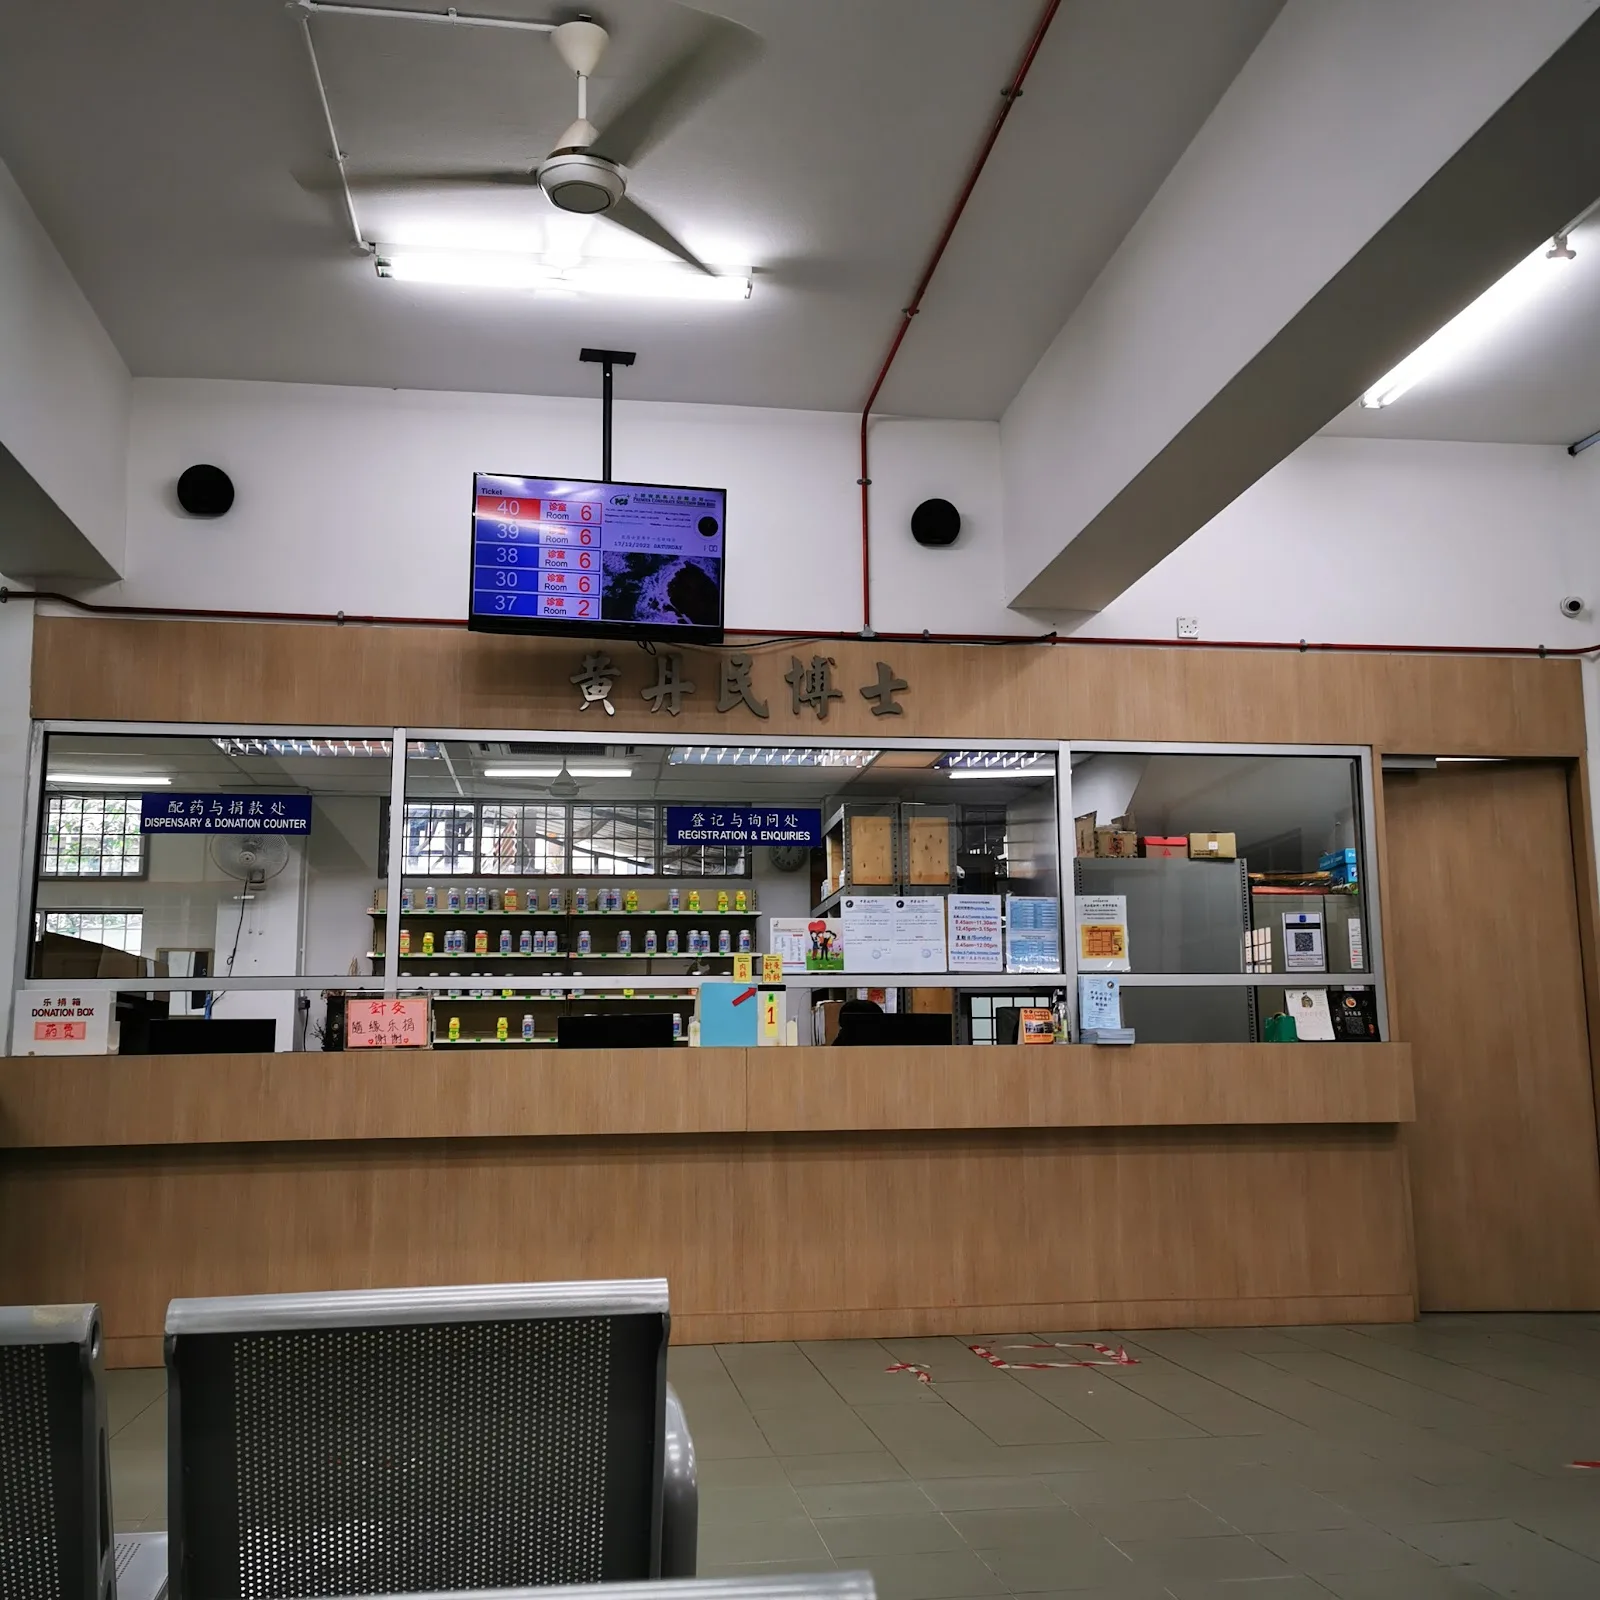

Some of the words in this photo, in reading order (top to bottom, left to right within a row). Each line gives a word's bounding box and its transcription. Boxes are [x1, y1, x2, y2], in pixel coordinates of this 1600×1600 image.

[496, 499, 520, 516] 40
[549, 502, 567, 511] 诊室
[581, 505, 592, 521] 6
[546, 511, 569, 520] Room
[496, 523, 519, 540] 39
[580, 529, 592, 545] 6
[545, 535, 569, 544] Room
[496, 547, 518, 564] 38
[547, 550, 566, 560] 诊室
[579, 552, 591, 569] 6
[544, 559, 568, 568] Room
[495, 571, 518, 588] 30
[547, 573, 565, 583] 诊室
[579, 576, 591, 593] 6
[544, 583, 568, 592] Room
[494, 595, 518, 611] 37
[546, 597, 564, 607] 诊室
[578, 599, 590, 616] 2
[543, 606, 567, 615] Room
[167, 799, 286, 816] 配药与捐款处
[144, 817, 202, 828] DISPENSARY
[205, 818, 212, 827] &
[214, 818, 261, 829] DONATION
[263, 818, 307, 829] COUNTER
[691, 812, 799, 828] 登记与询问处
[678, 829, 748, 840] REGISTRATION
[751, 830, 757, 841] &
[760, 830, 811, 841] ENQUIRIES
[43, 998, 82, 1007] 乐捐箱
[32, 1008, 75, 1017] DONATION
[77, 1007, 94, 1017] BOX
[767, 1006, 776, 1025] 1
